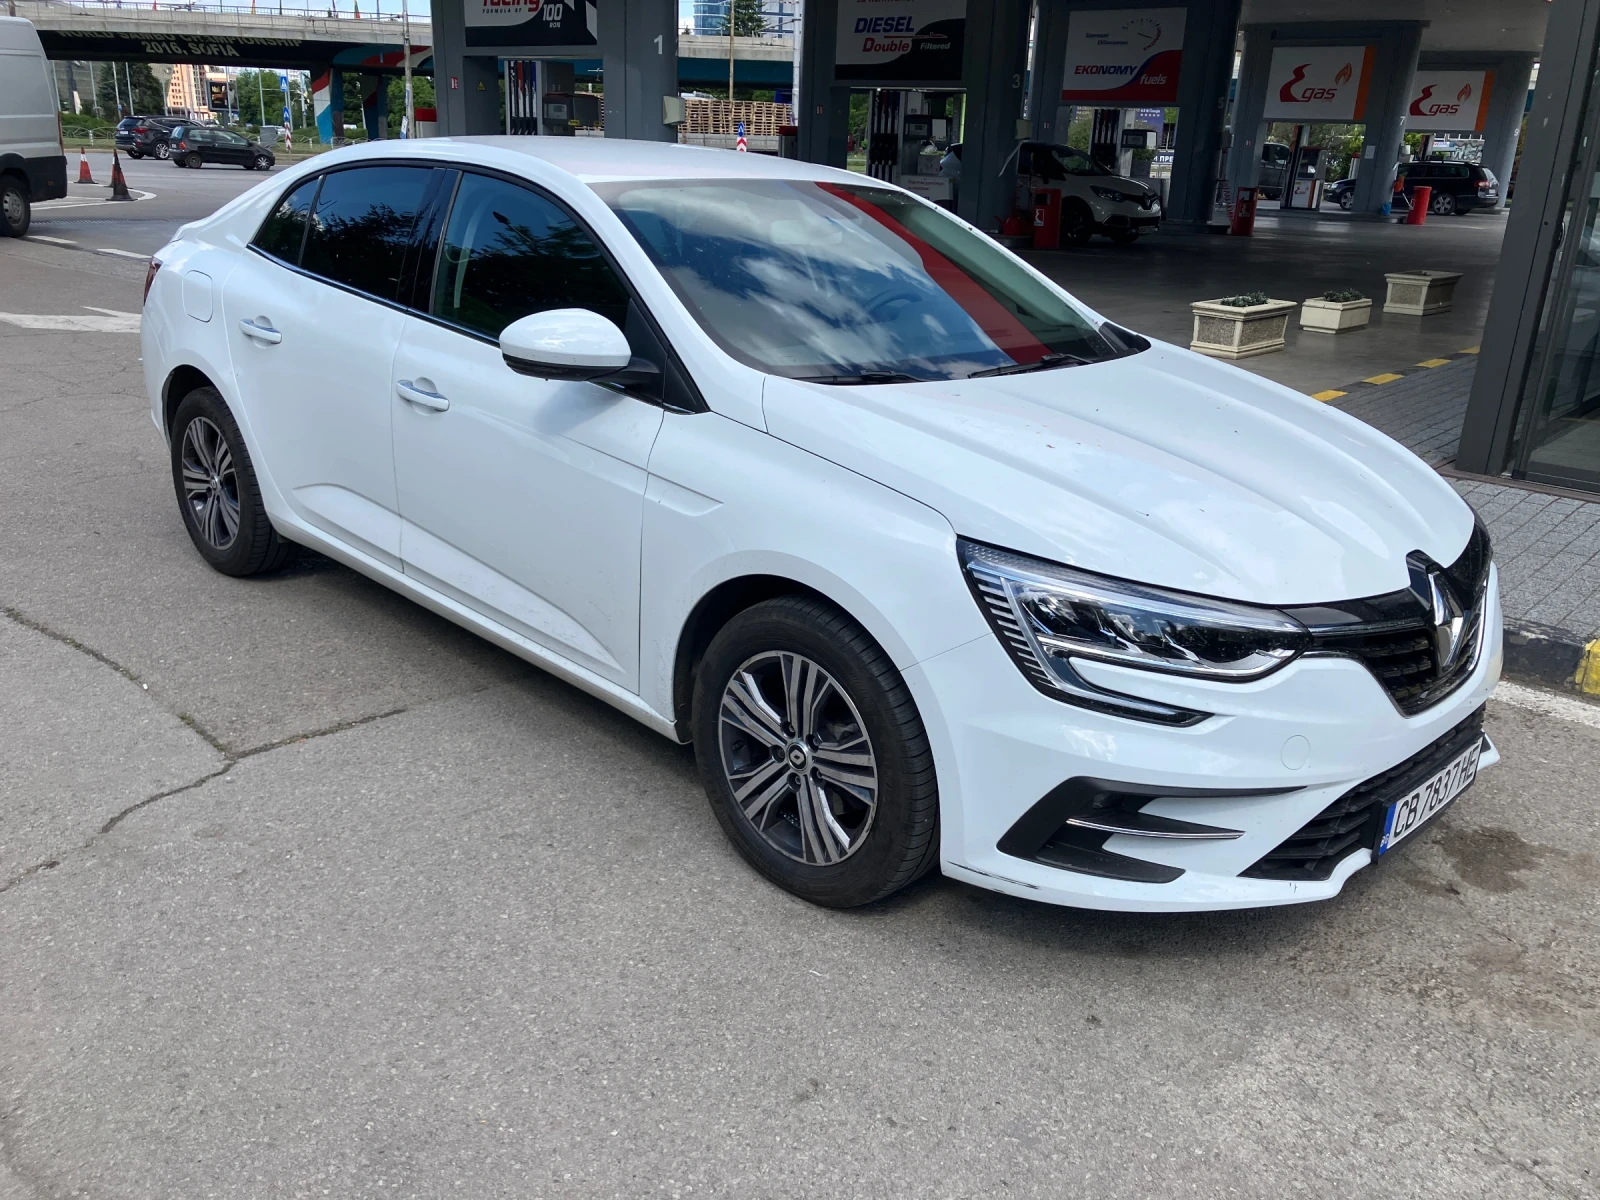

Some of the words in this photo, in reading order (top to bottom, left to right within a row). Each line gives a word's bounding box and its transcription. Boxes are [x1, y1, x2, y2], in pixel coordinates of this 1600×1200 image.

[543, 4, 563, 21] 100
[854, 16, 915, 33] DIESEL
[141, 41, 188, 56] 2016,
[188, 42, 240, 57] SOFIA
[653, 35, 663, 55] 1
[862, 37, 910, 52] Double
[920, 42, 951, 50] Filtered
[1074, 65, 1138, 75] EKONOMY
[1012, 73, 1020, 88] 3
[1139, 74, 1168, 85] fuels
[1394, 793, 1420, 838] CB
[1419, 760, 1461, 821] 7837
[1456, 744, 1481, 790] HE
